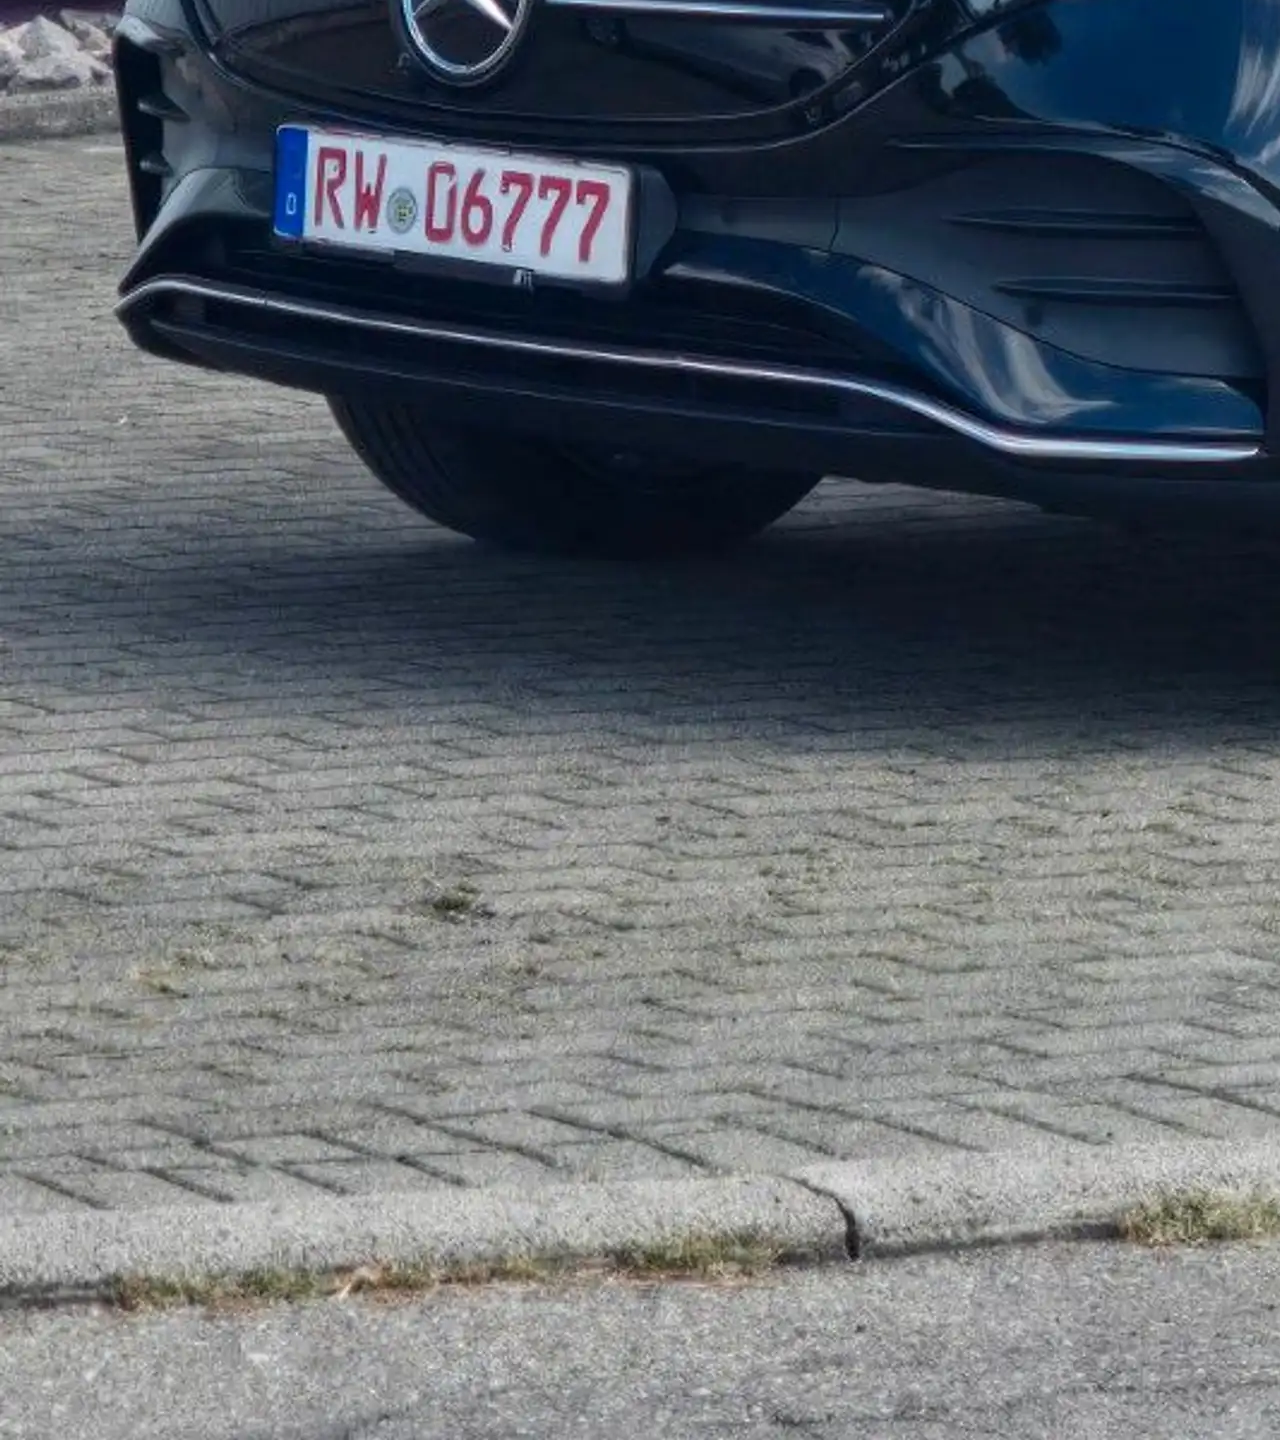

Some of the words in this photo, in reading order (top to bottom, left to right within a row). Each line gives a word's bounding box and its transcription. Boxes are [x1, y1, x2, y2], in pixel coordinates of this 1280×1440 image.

[285, 192, 297, 216] D
[314, 145, 387, 232] RW
[424, 161, 609, 264] 06777
